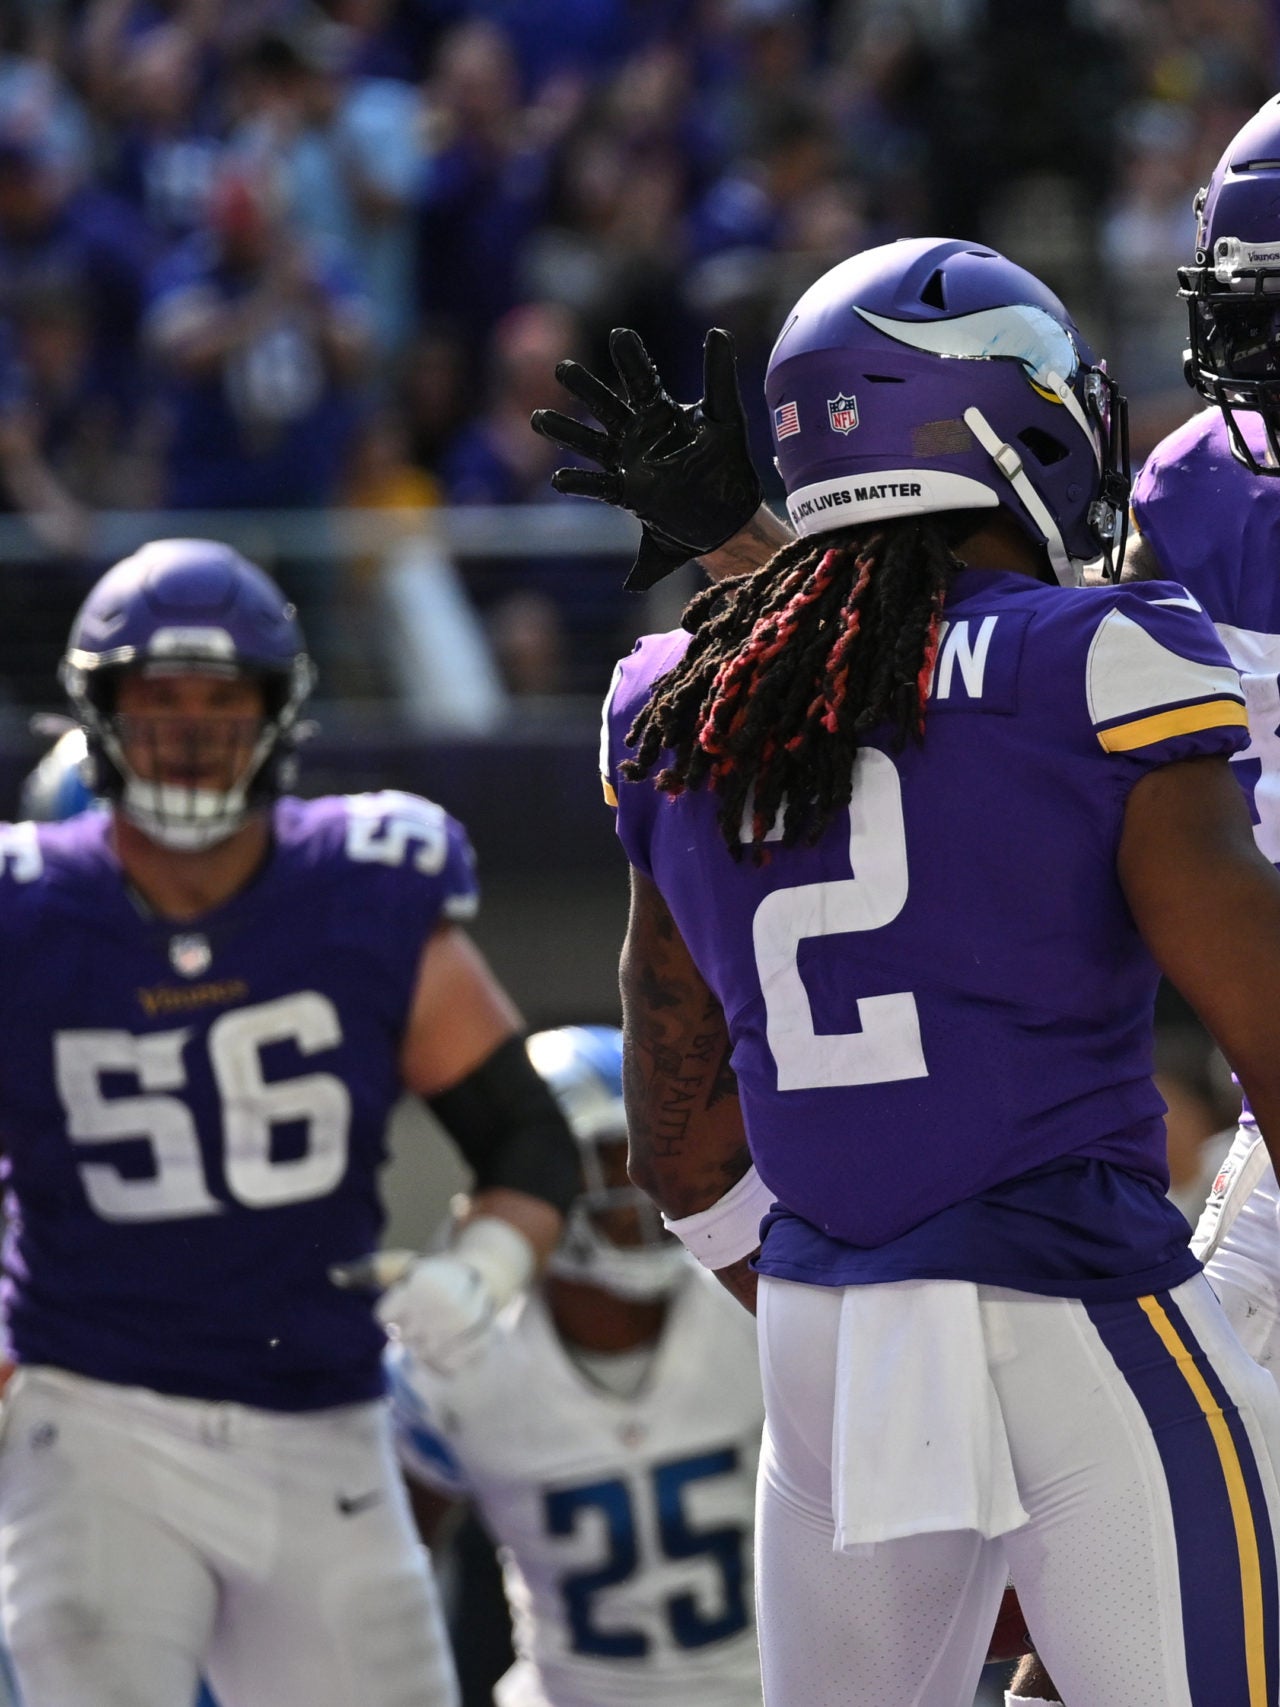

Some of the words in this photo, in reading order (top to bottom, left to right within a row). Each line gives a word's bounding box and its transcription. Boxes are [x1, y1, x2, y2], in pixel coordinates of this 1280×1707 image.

[834, 411, 855, 428] NFL
[791, 500, 815, 524] BACK
[813, 490, 852, 511] LIVES
[854, 483, 921, 502] MATTER
[740, 746, 930, 1092] 2
[53, 990, 352, 1223] 56
[654, 1076, 706, 1157] FAITH
[545, 1448, 749, 1658] 25
